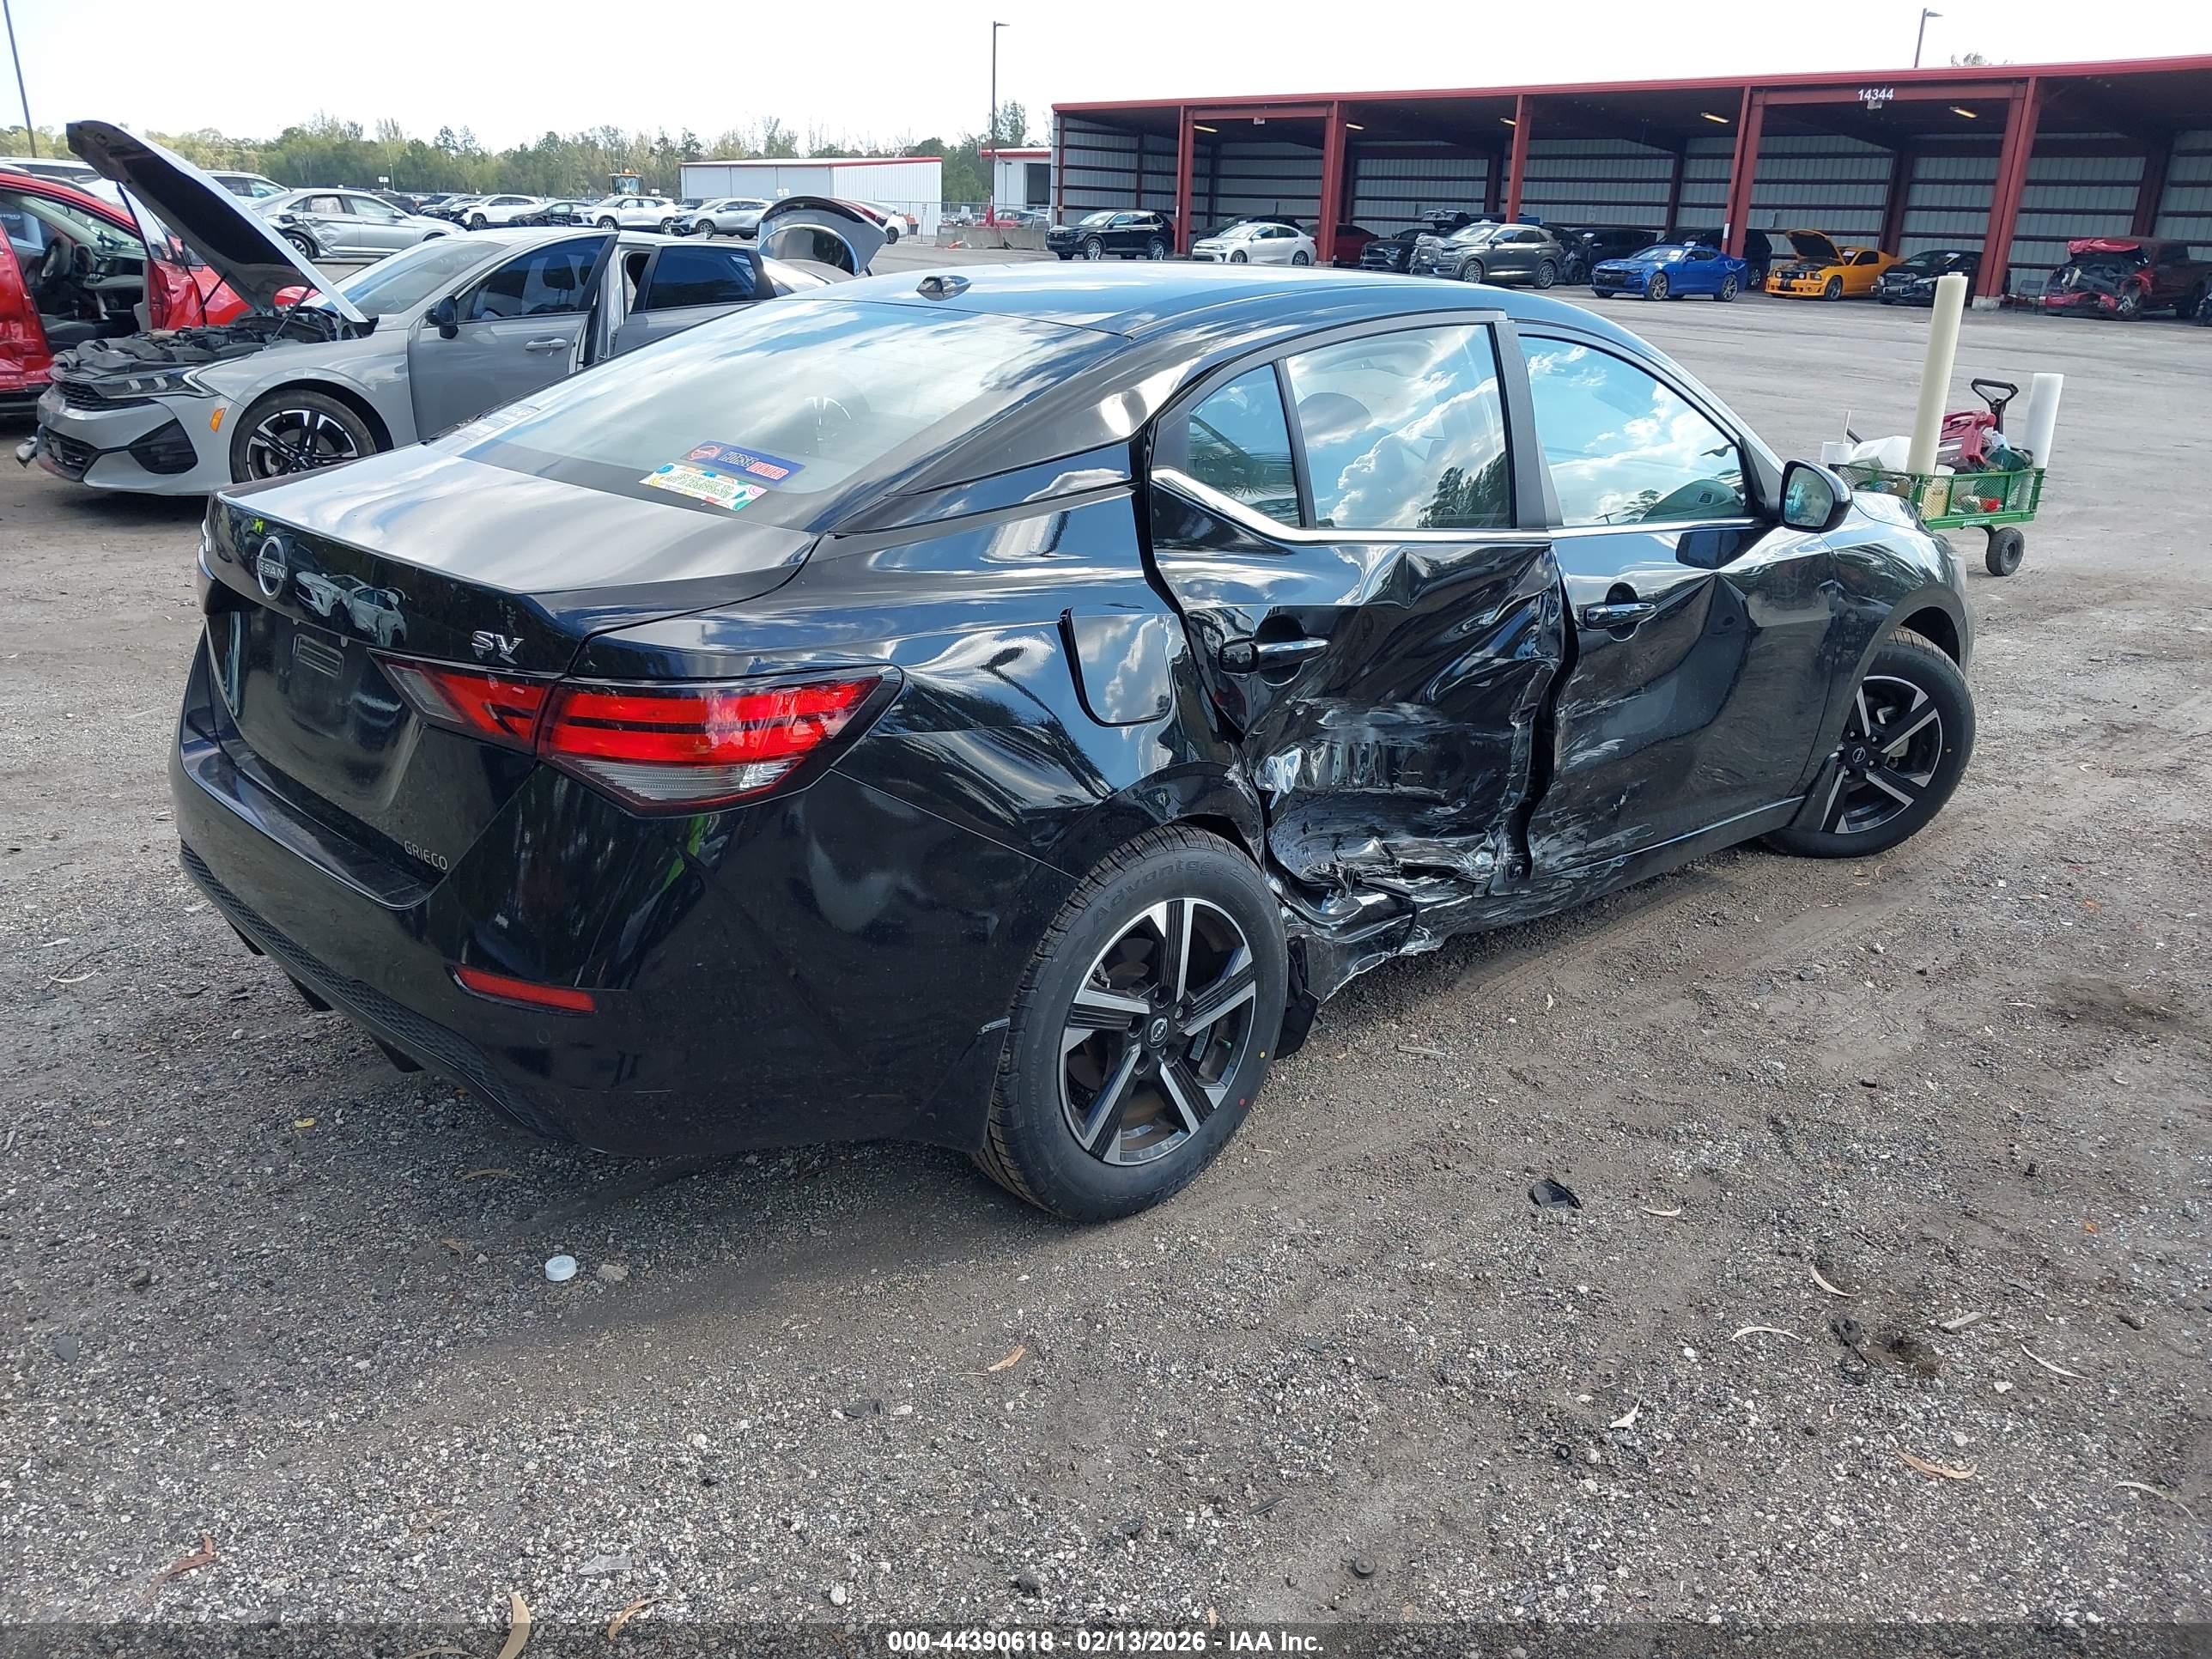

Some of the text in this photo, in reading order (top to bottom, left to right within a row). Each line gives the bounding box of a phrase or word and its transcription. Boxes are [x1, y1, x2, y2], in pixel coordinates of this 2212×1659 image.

[1857, 88, 1895, 101] 14344
[471, 630, 526, 655] SV
[404, 840, 448, 871] GRIECO
